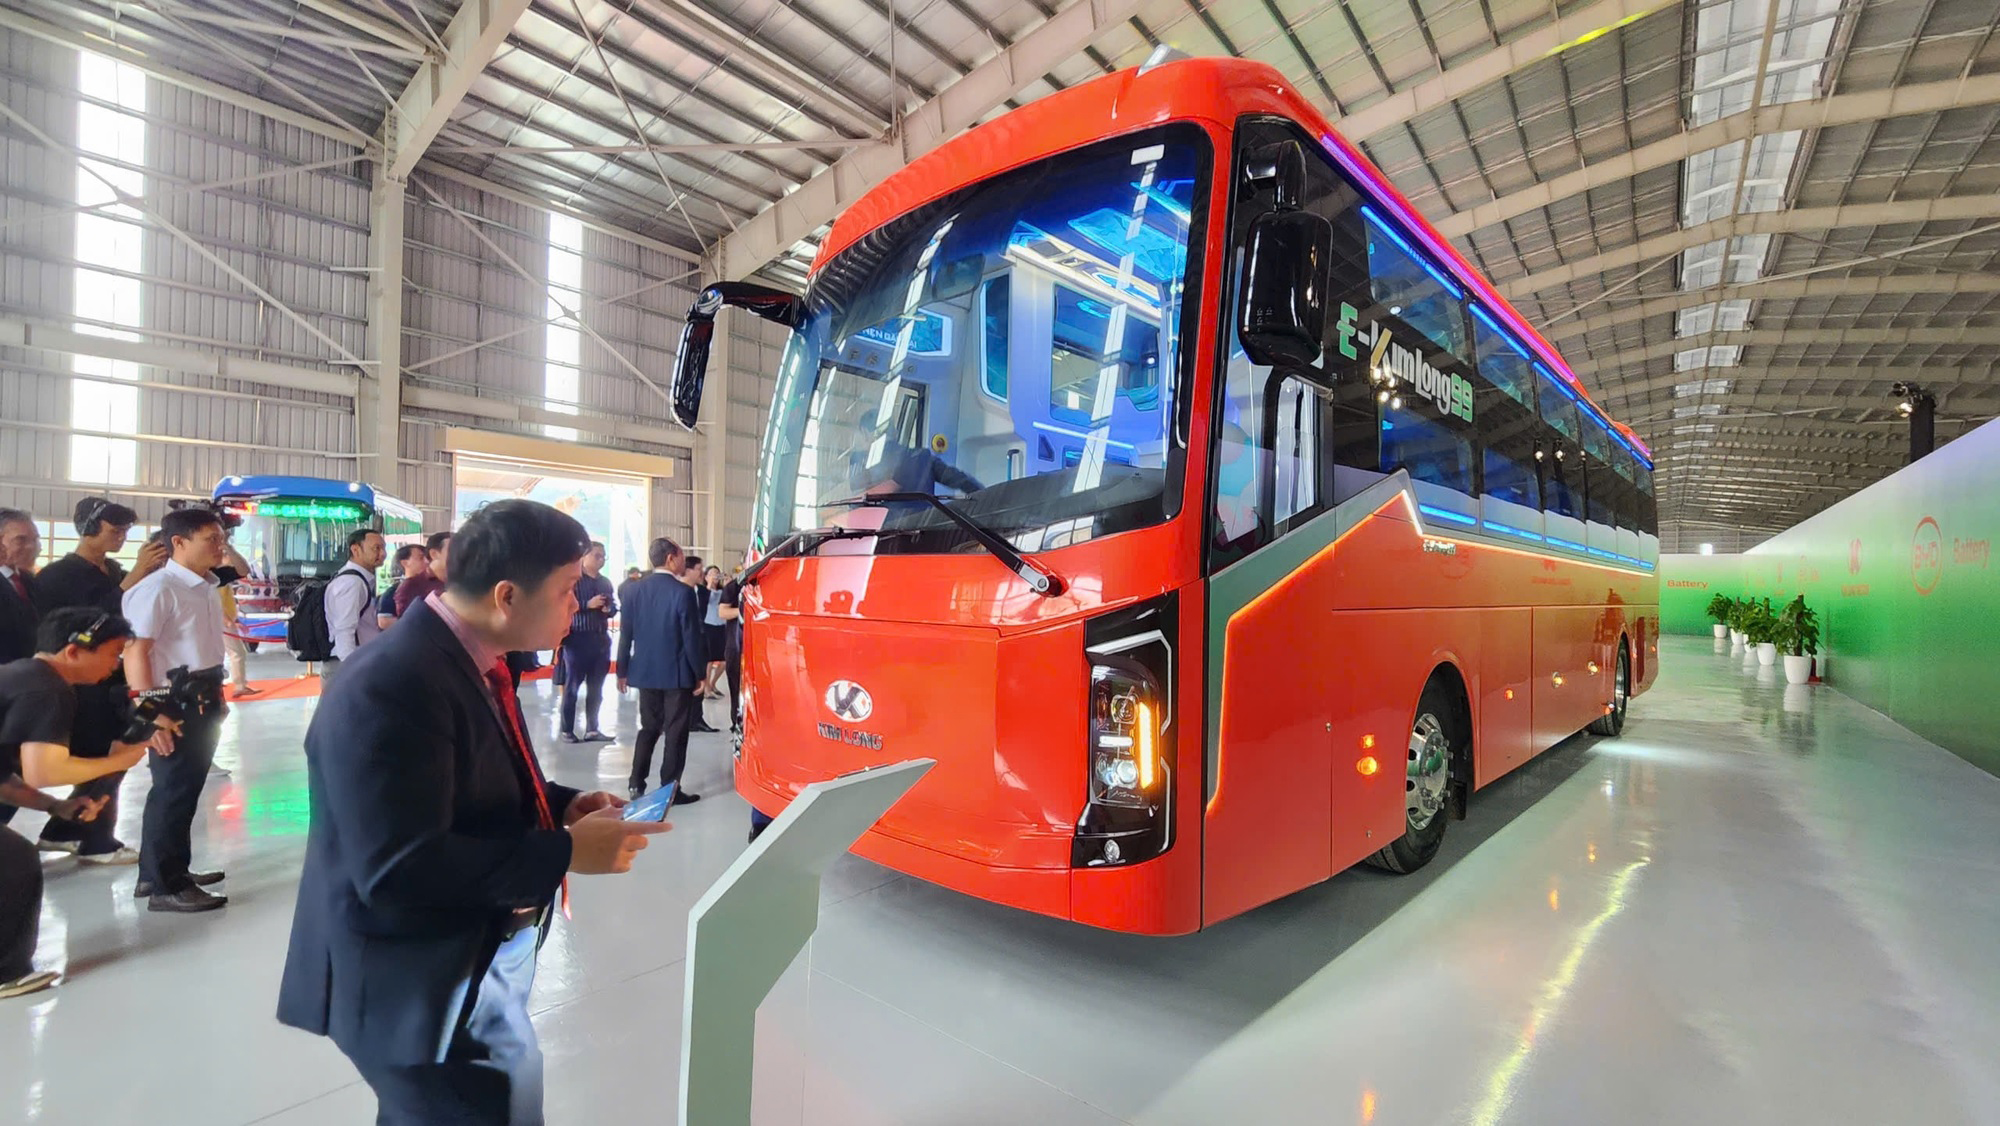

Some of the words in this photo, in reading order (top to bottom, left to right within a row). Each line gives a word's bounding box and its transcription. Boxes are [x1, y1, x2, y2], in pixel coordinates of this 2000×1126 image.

[1953, 537, 1990, 569] Battery
[1667, 579, 1708, 589] Battery
[139, 688, 170, 698] RONIN
